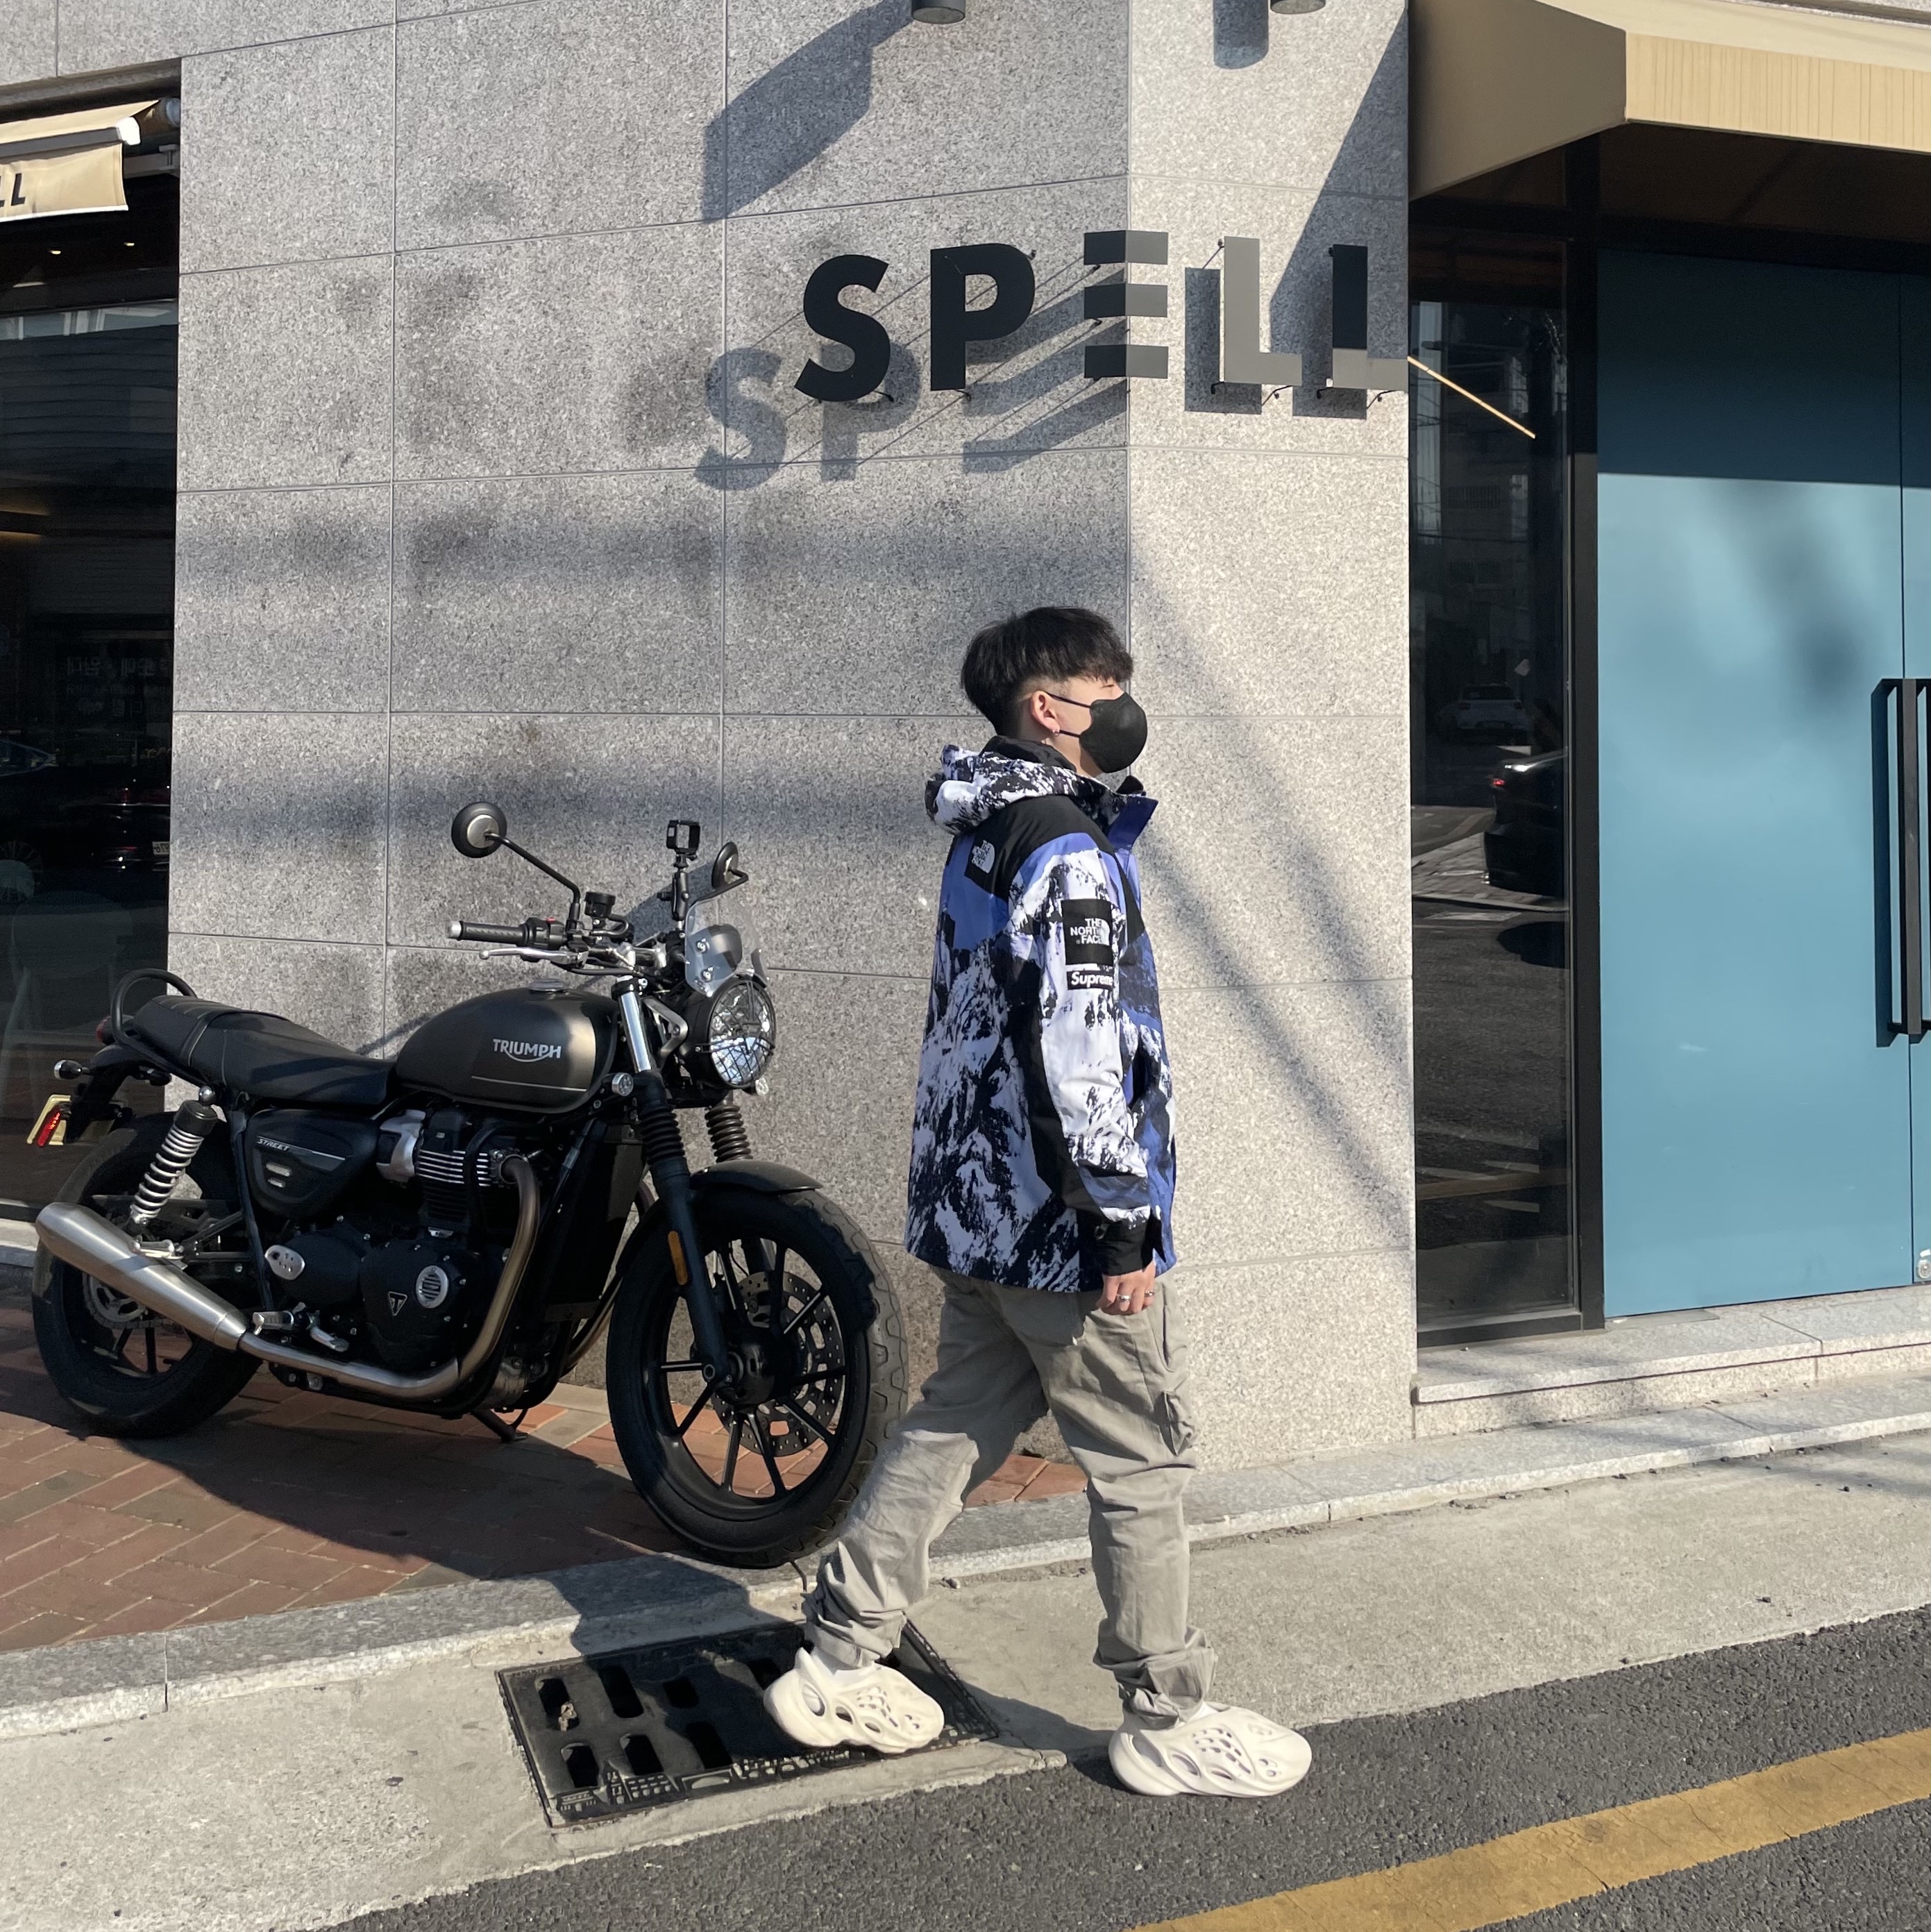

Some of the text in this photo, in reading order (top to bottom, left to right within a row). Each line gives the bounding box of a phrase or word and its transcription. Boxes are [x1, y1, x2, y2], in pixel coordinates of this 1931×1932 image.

[795, 230, 1408, 403] SPELL
[1085, 918, 1102, 927] THE
[1081, 934, 1102, 944] FACE
[1071, 971, 1113, 988] Supreme
[493, 1039, 562, 1061] TRIUMPH
[256, 1138, 290, 1152] STREET
